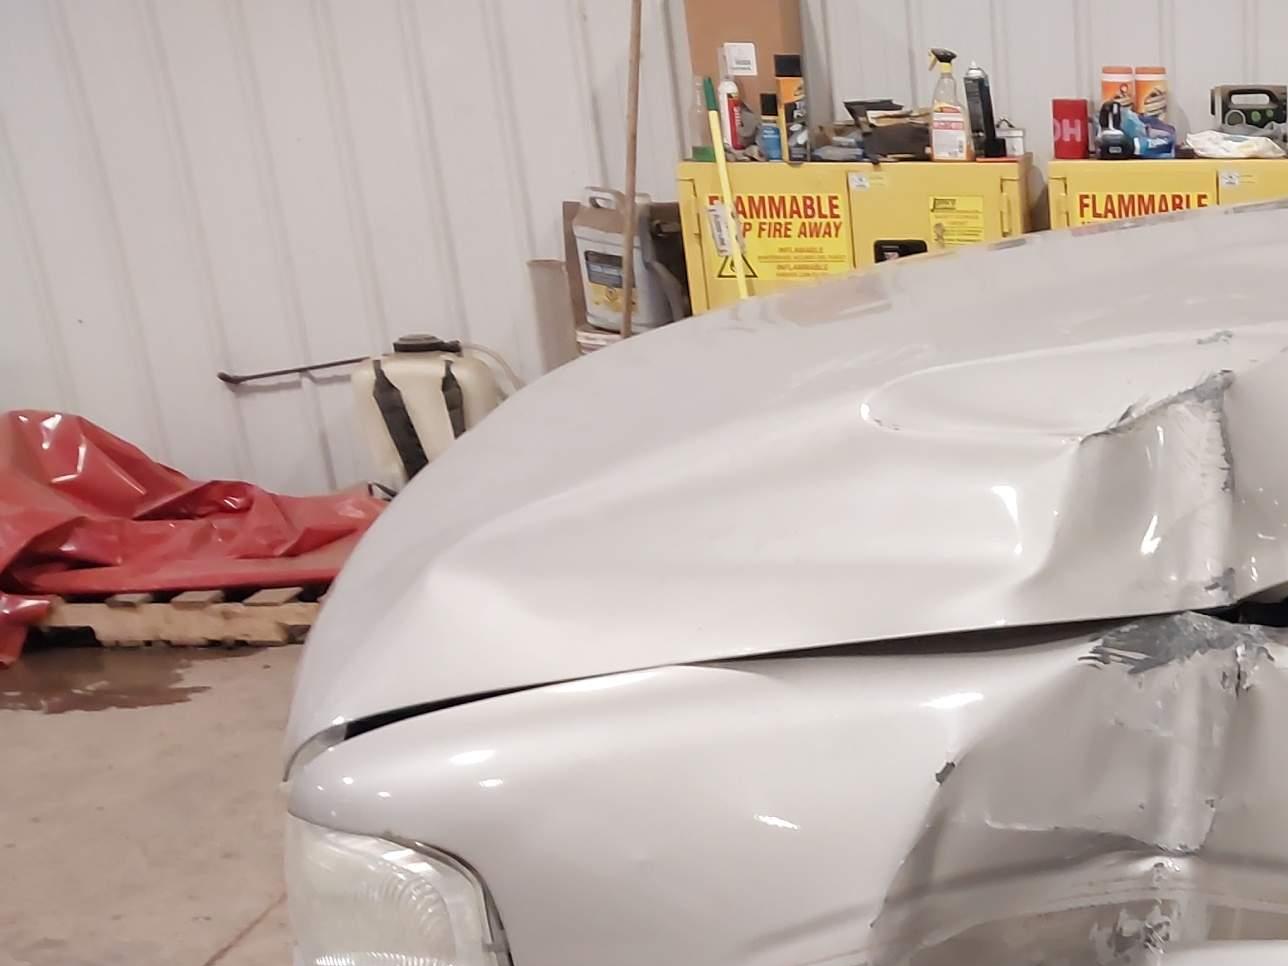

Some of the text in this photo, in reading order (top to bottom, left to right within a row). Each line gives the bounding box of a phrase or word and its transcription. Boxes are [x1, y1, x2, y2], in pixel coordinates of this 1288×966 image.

[708, 195, 841, 219] AMMABLE
[757, 222, 793, 239] FIRE
[797, 222, 843, 239] AWAY
